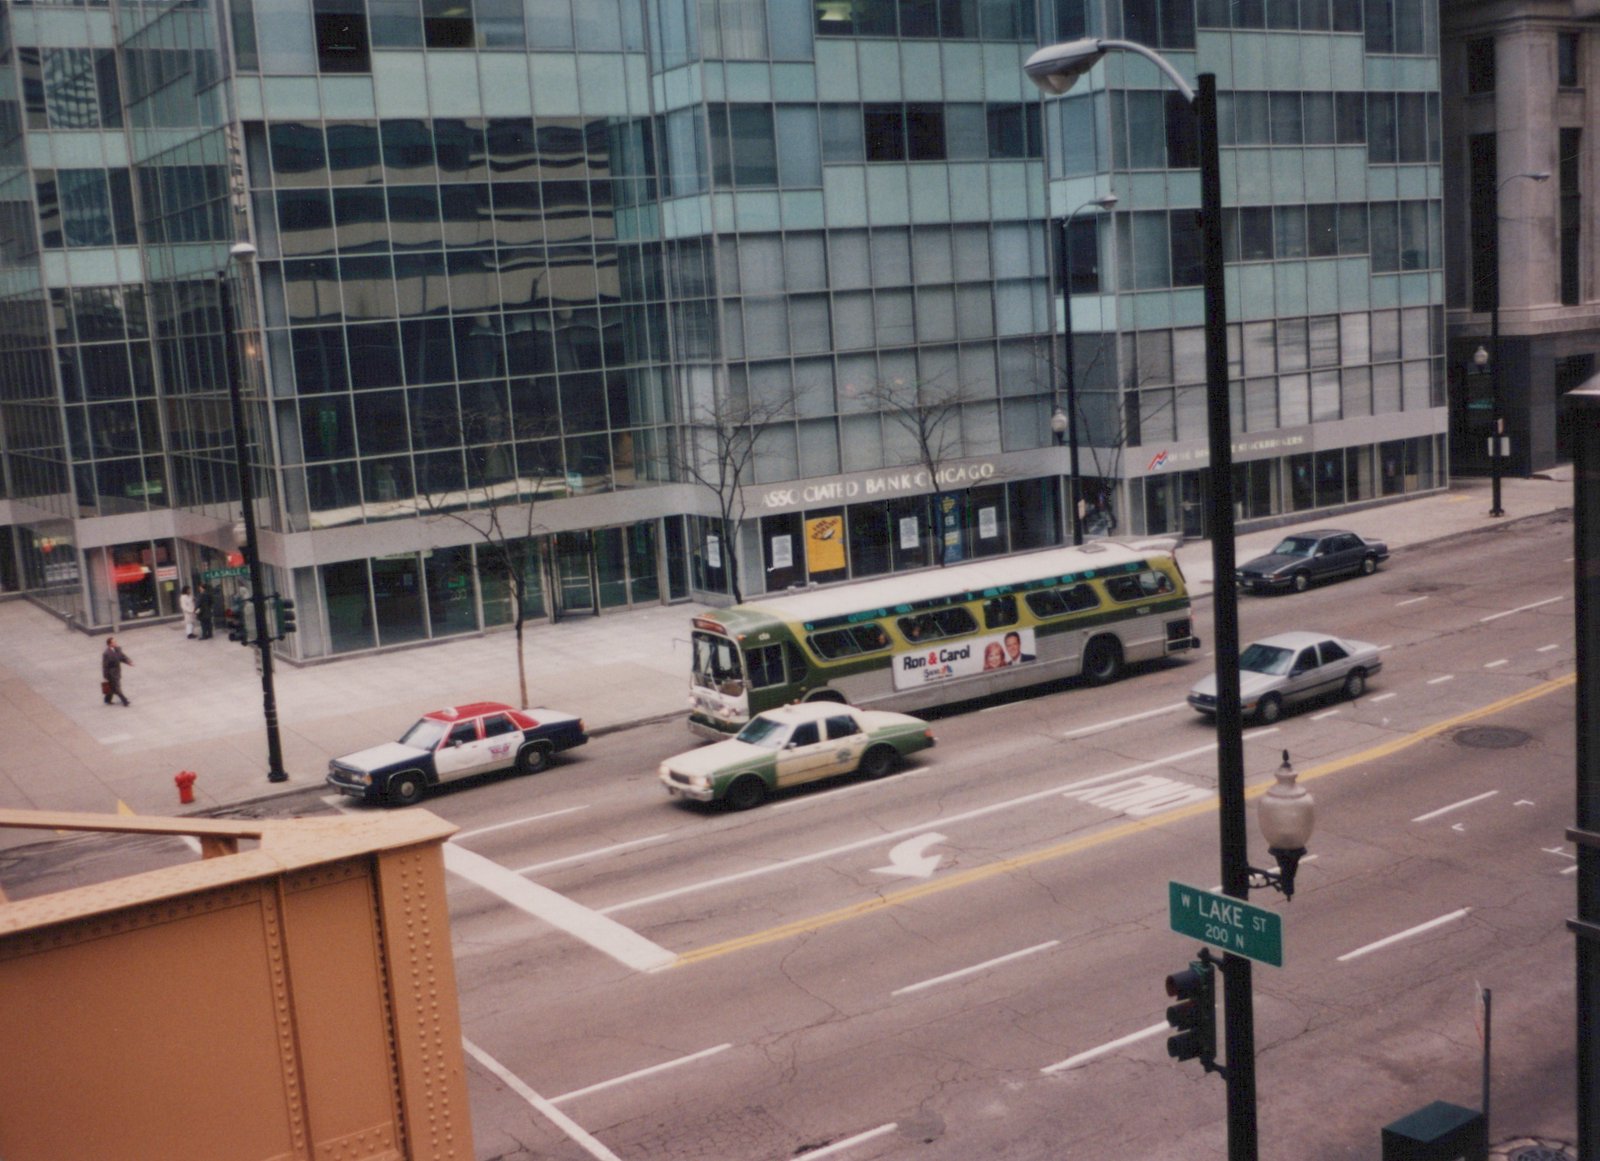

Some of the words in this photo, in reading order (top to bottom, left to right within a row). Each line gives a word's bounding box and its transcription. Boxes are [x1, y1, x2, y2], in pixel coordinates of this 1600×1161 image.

[866, 473, 911, 494] BANK
[903, 656, 927, 671] Ron
[928, 651, 938, 666] &
[940, 644, 971, 663] Carol
[1181, 893, 1190, 908] W
[1198, 895, 1244, 929] LAKE
[1252, 916, 1267, 933] ST
[1204, 924, 1229, 943] 200
[1235, 934, 1245, 949] N
